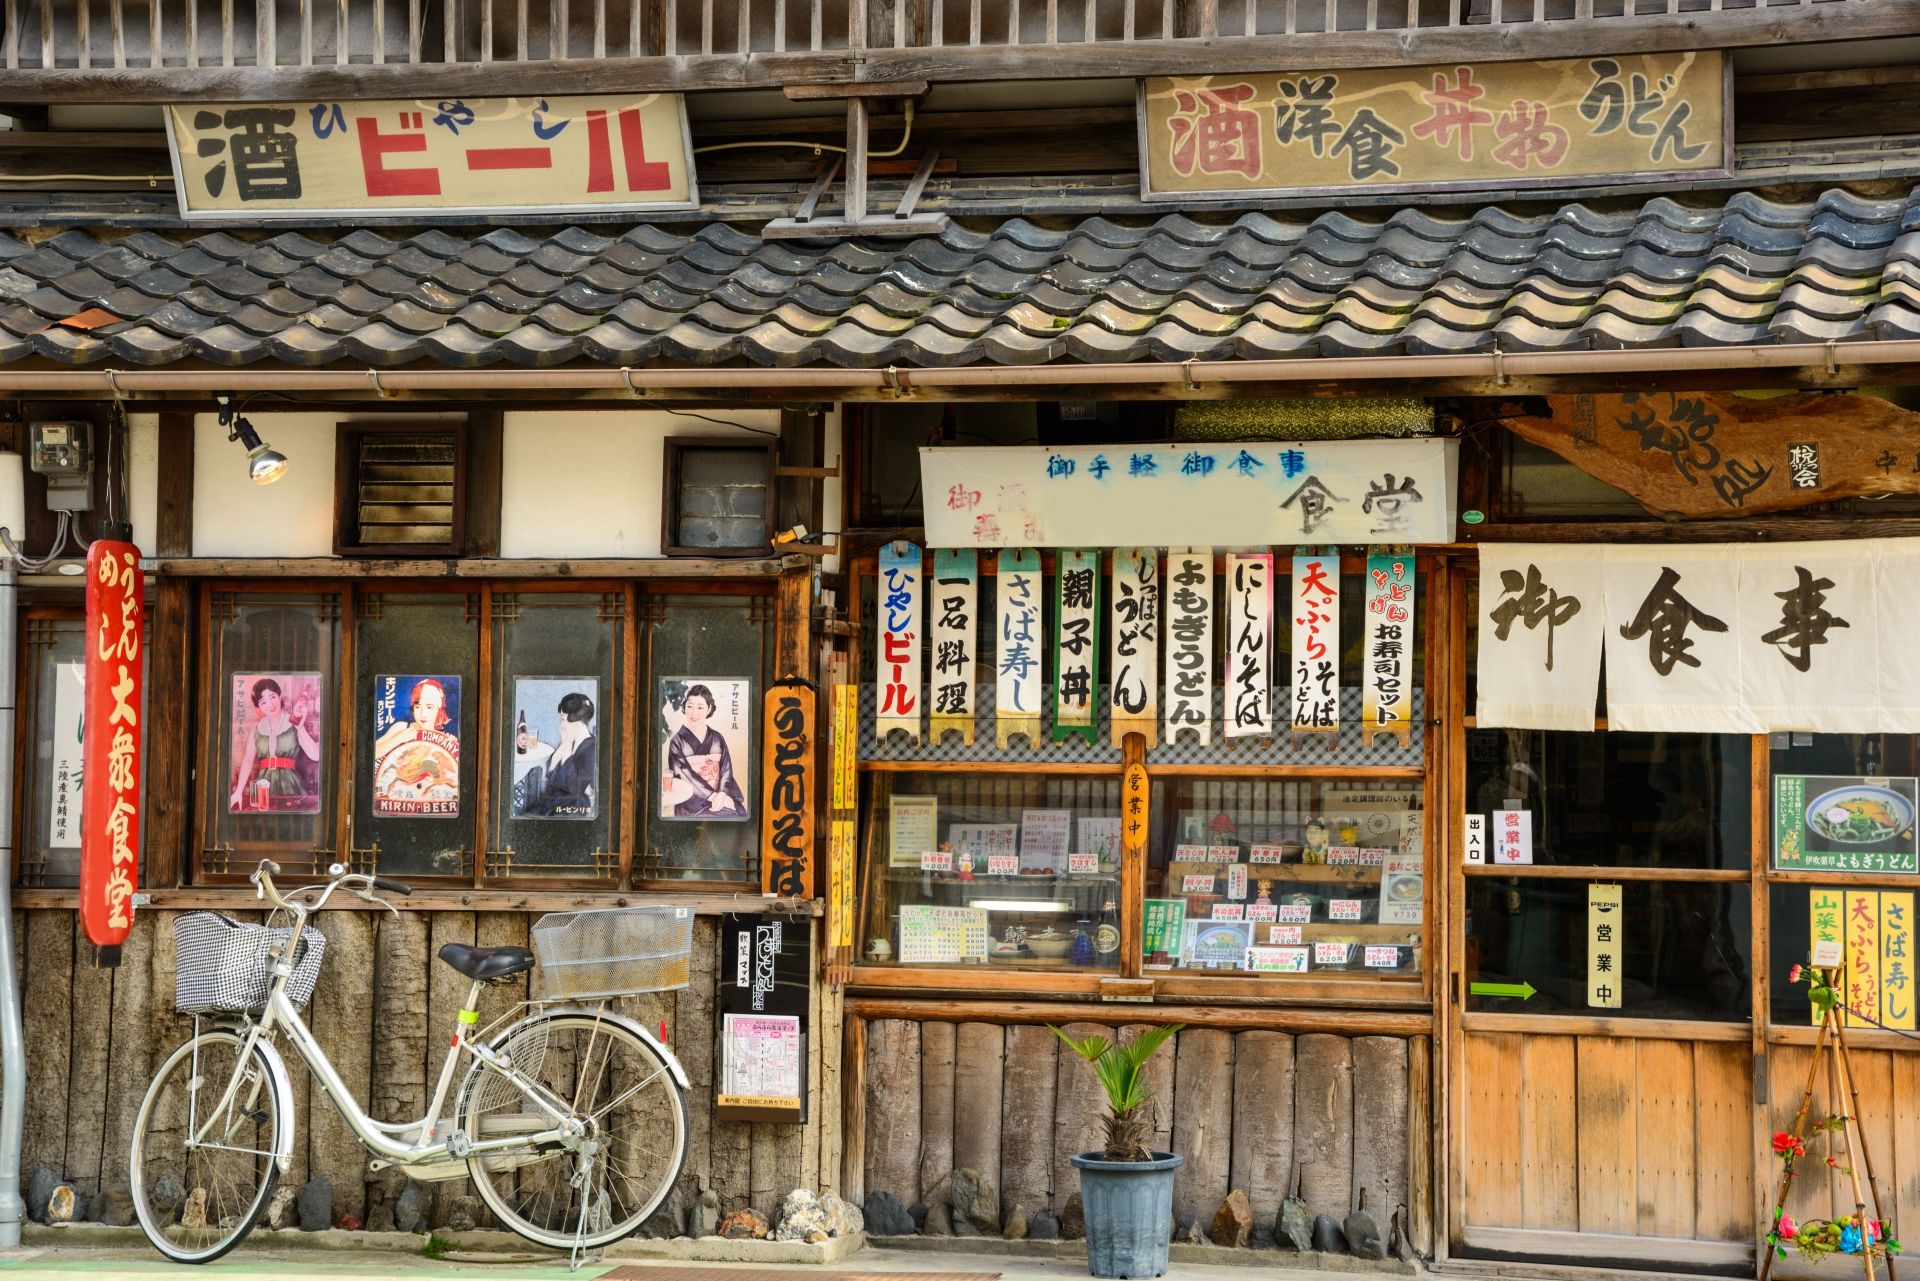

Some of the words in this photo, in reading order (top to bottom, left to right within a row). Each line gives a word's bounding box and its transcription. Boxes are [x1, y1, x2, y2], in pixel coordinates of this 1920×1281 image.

[194, 108, 302, 201] 酒
[309, 99, 572, 140] ひやし
[356, 108, 672, 197] ビール
[1169, 82, 1264, 181] 酒
[1273, 74, 1408, 182] 洋食
[1412, 67, 1572, 171] 丼物
[1578, 58, 1712, 164] うどん
[1279, 473, 1424, 535] 食堂
[98, 550, 118, 661] めし
[117, 552, 139, 661] うどん
[1137, 556, 1158, 643] しっぽく
[1296, 561, 1338, 660] 天ぷら
[1369, 567, 1390, 614] そば
[1386, 562, 1412, 623] うどん
[1490, 563, 1851, 677] 御食事
[880, 567, 916, 716] ひやしビール
[936, 577, 971, 714] 一品料理
[999, 574, 1039, 712] さば寿し
[1060, 568, 1095, 708] 親子丼
[1113, 581, 1147, 715] うどん
[1169, 560, 1209, 726] よもぎうどん
[1235, 562, 1267, 728] にしんそば
[1372, 623, 1404, 726] お寿司セット
[385, 677, 396, 725] キリンビール
[730, 683, 740, 731] アサヒビール
[1294, 661, 1311, 726] うどん
[1313, 660, 1337, 728] そば
[422, 730, 460, 754] COMPANY
[104, 665, 138, 929] 大衆食堂
[380, 800, 416, 813] KIRIN
[423, 801, 458, 813] BEER
[770, 697, 807, 897] うどんそば
[1126, 773, 1144, 836] 営業中
[1469, 819, 1480, 860] 出入口
[1504, 812, 1521, 862] 営業中
[1590, 901, 1619, 909] PEPSI
[1836, 853, 1914, 869] よもぎうどん
[1596, 923, 1613, 1004] 営業中
[1851, 897, 1875, 974] 天ぷら
[1884, 903, 1909, 1020] さば寿し
[1850, 984, 1863, 1016] そば
[1865, 974, 1878, 1023] うどん
